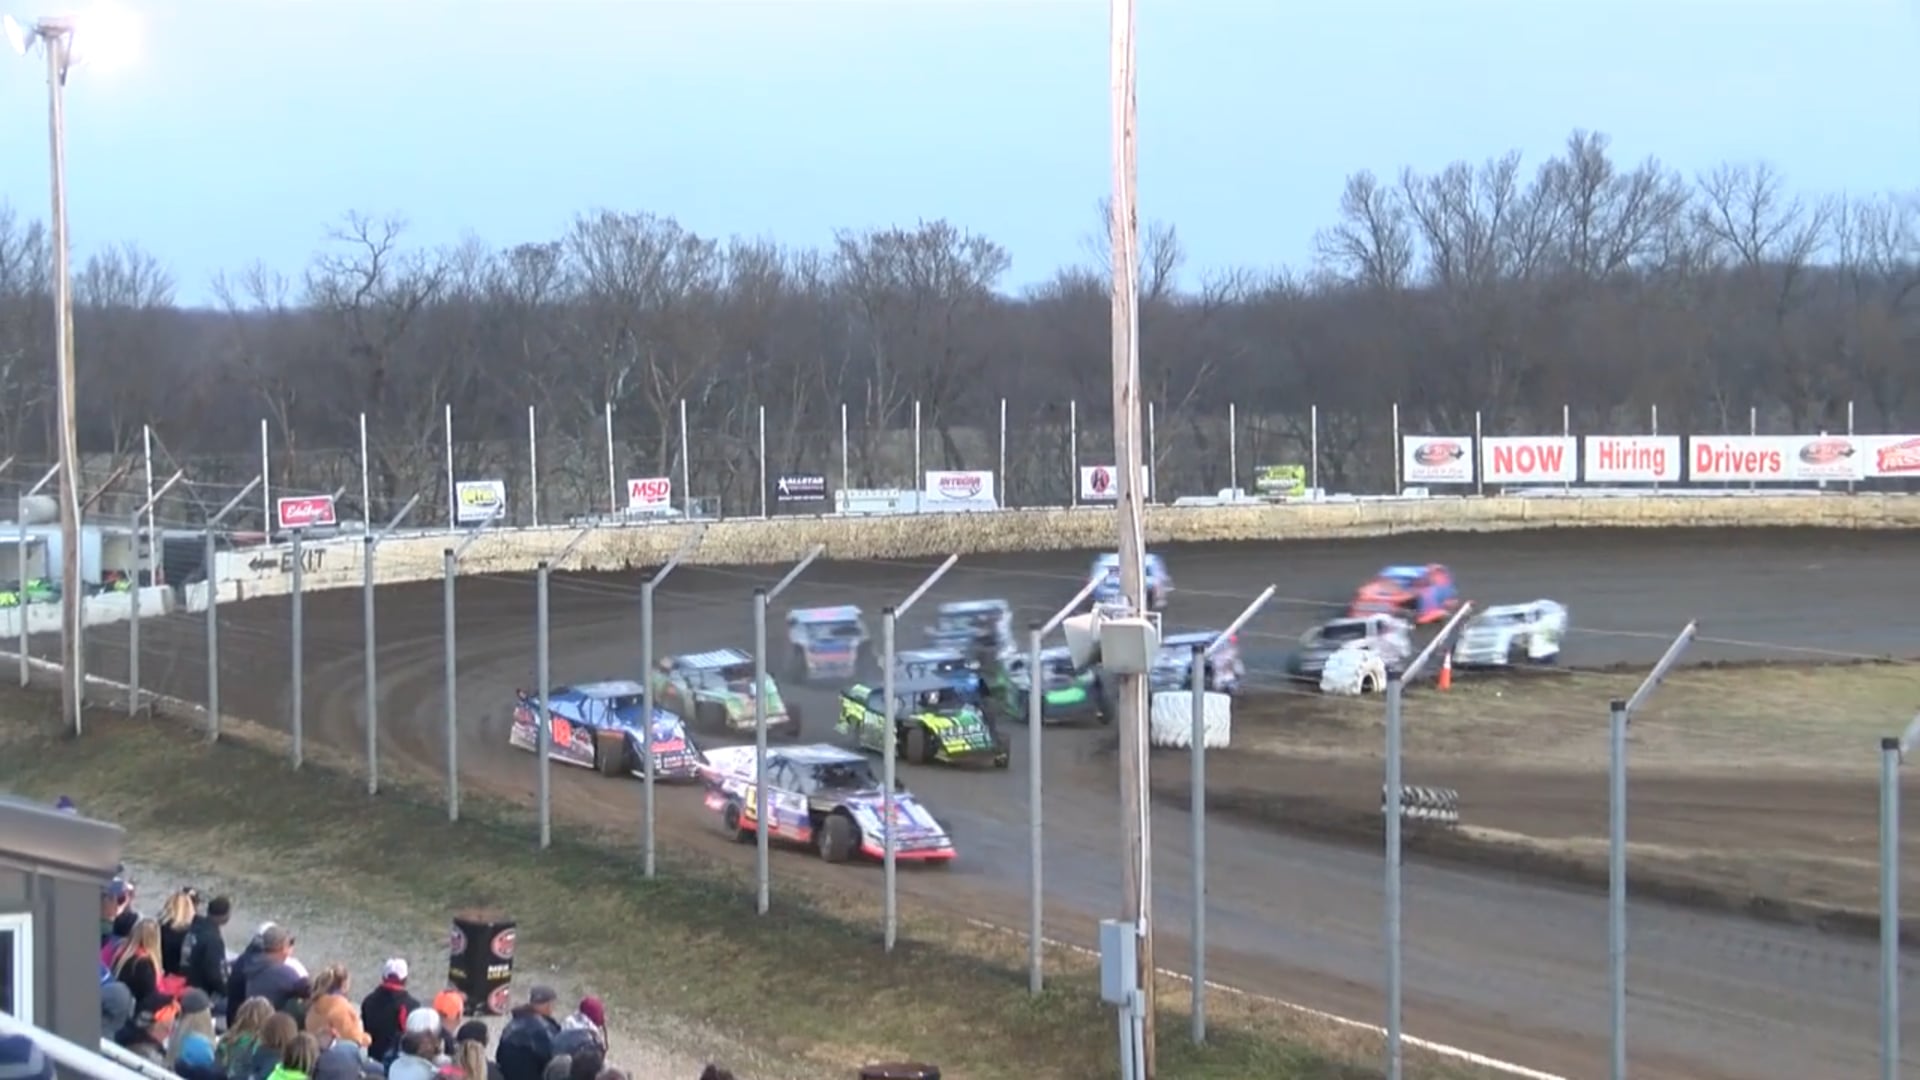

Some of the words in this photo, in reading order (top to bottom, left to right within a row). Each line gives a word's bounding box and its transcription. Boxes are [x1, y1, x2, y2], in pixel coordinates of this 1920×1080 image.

[1494, 445, 1564, 474] NOW
[1599, 441, 1665, 476] Hiring
[1696, 444, 1781, 473] Drivers
[631, 481, 669, 498] MSD
